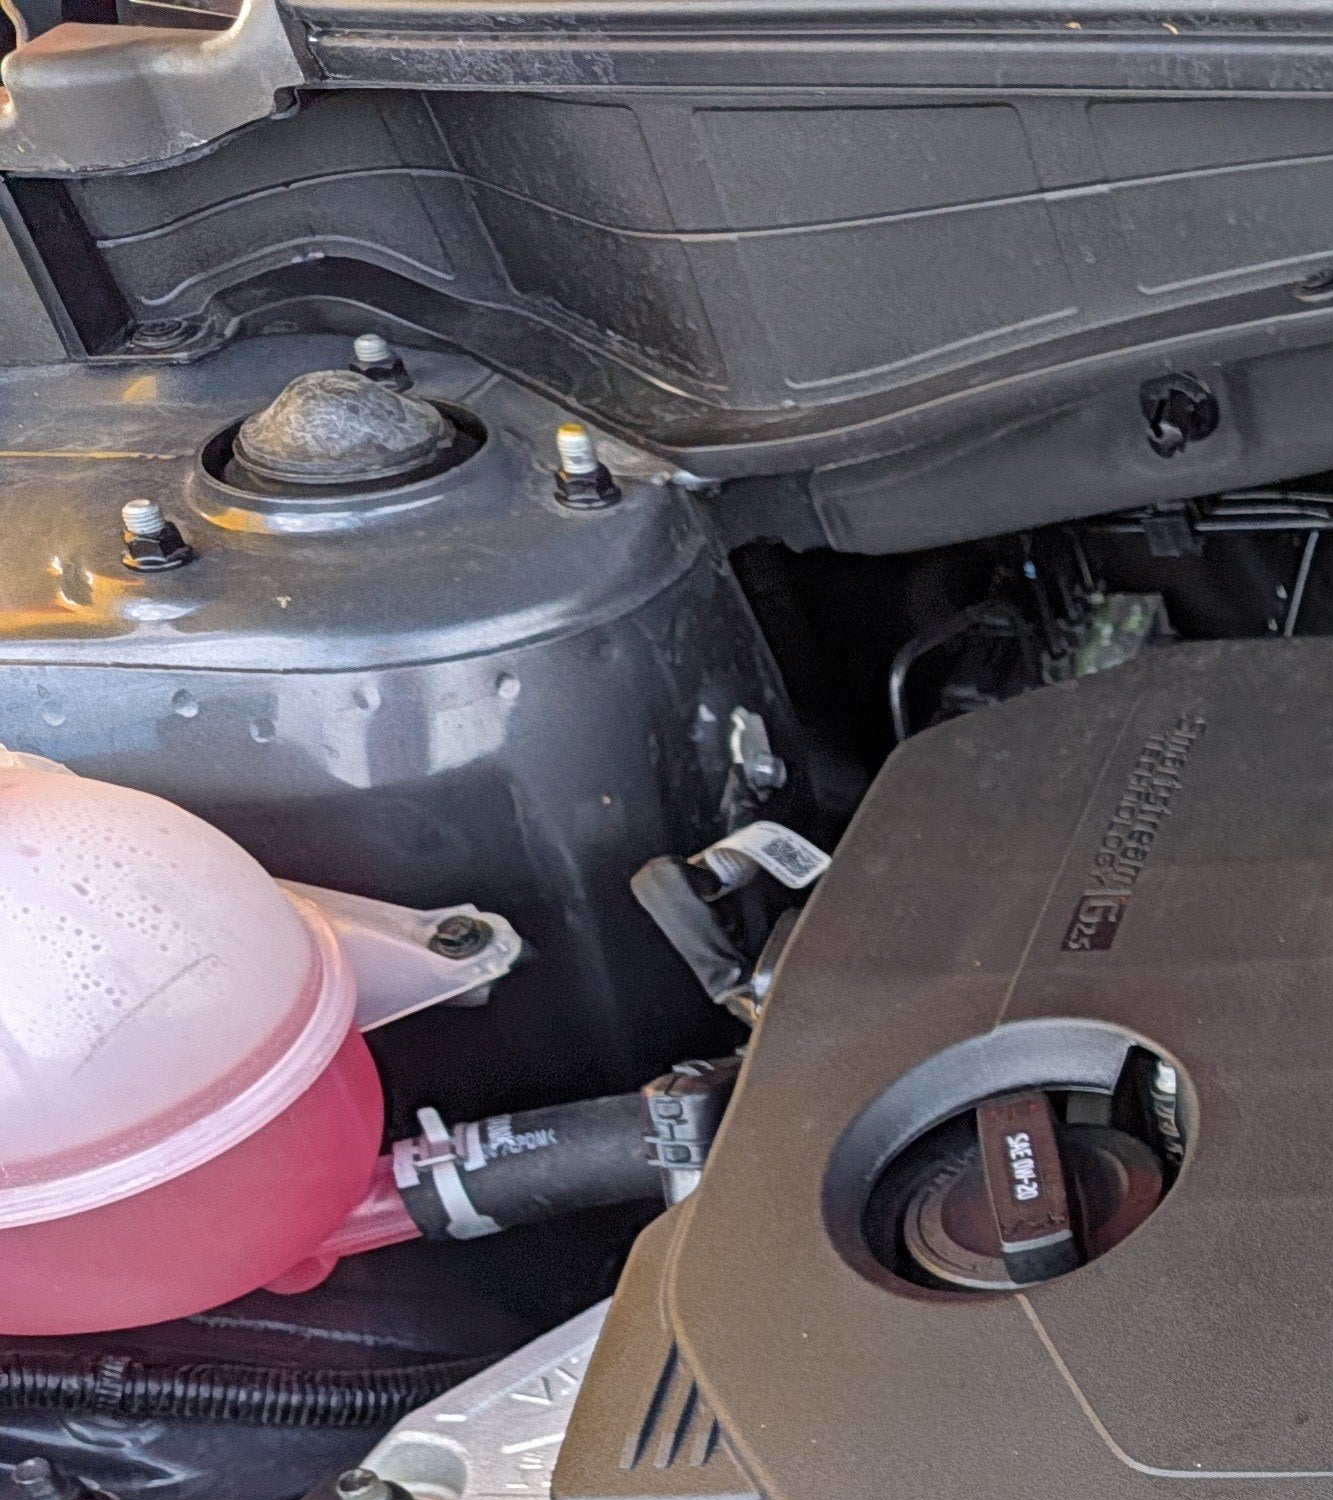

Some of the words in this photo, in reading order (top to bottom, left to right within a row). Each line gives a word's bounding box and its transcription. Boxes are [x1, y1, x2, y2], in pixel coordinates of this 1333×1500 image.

[1090, 732, 1166, 886] TECHNOLOGY
[1112, 714, 1207, 886] Smartstream
[1006, 1131, 1035, 1161] SAE
[1009, 1157, 1040, 1201] 0W-20
